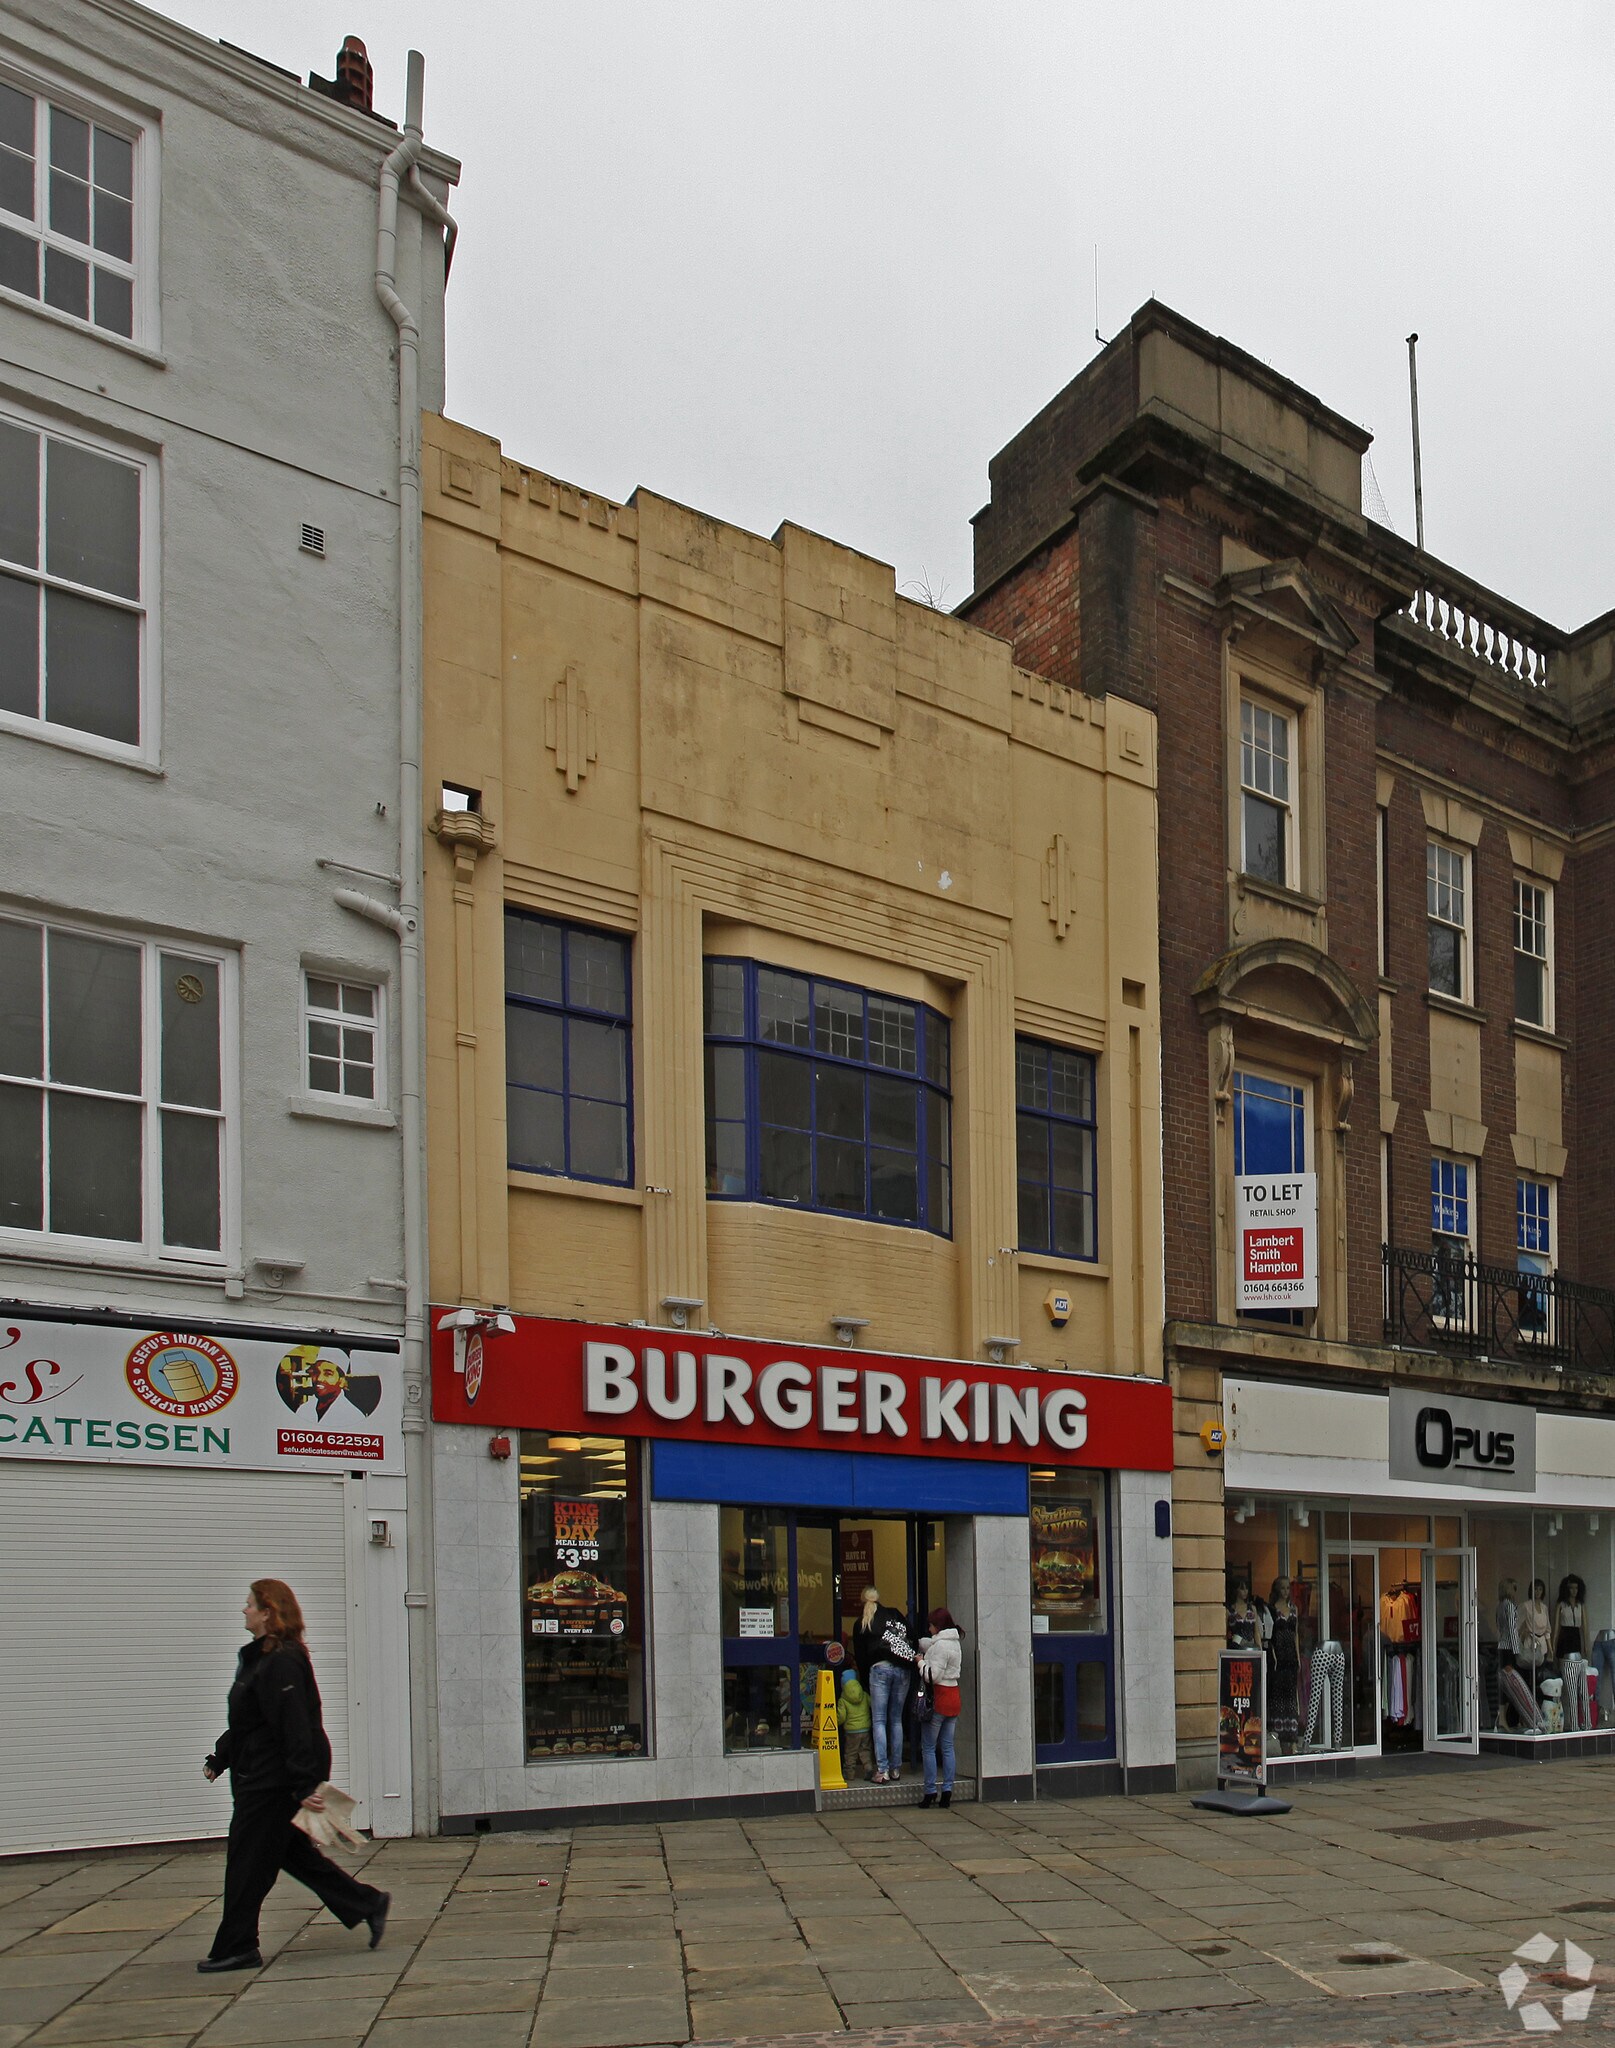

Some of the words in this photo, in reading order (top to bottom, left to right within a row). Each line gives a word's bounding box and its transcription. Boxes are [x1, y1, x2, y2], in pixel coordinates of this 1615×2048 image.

[1242, 1185, 1267, 1202] TO
[1271, 1183, 1303, 1201] LET
[1249, 1209, 1275, 1217] RETAIL
[1276, 1208, 1297, 1216] SHOP
[1520, 1223, 1542, 1238] Hking
[1249, 1234, 1295, 1248] Lambert
[1249, 1248, 1281, 1261] Smith
[1249, 1261, 1298, 1275] Hampton
[1243, 1283, 1270, 1293] 01604
[1271, 1282, 1305, 1292] 664366
[1055, 1300, 1068, 1309] ADT
[1243, 1293, 1292, 1301] www.lsh.co.uk
[132, 1335, 170, 1365] SEFU'S
[172, 1333, 220, 1357] INDIAN
[216, 1355, 234, 1389] TIFFIN
[132, 1378, 185, 1415] EXPRESS
[189, 1389, 230, 1415] LUNCH
[582, 1341, 908, 1439] BURGER
[920, 1376, 1088, 1450] KING
[281, 1431, 324, 1444] 01604
[327, 1434, 380, 1448] 622594
[283, 1446, 379, 1458] sefu.delicatessen@mail.com
[553, 1501, 600, 1515] KING
[574, 1515, 599, 1525] THE
[555, 1523, 599, 1541] DAY
[556, 1548, 599, 1568] £3.99
[845, 1550, 859, 1561] HAVE
[860, 1550, 867, 1560] IT
[843, 1562, 857, 1572] YOUR
[857, 1561, 869, 1571] WAY
[1408, 1622, 1419, 1637] £7
[1230, 1661, 1253, 1674] KING
[1230, 1682, 1253, 1697] DAY
[1233, 1697, 1251, 1715] £1.99
